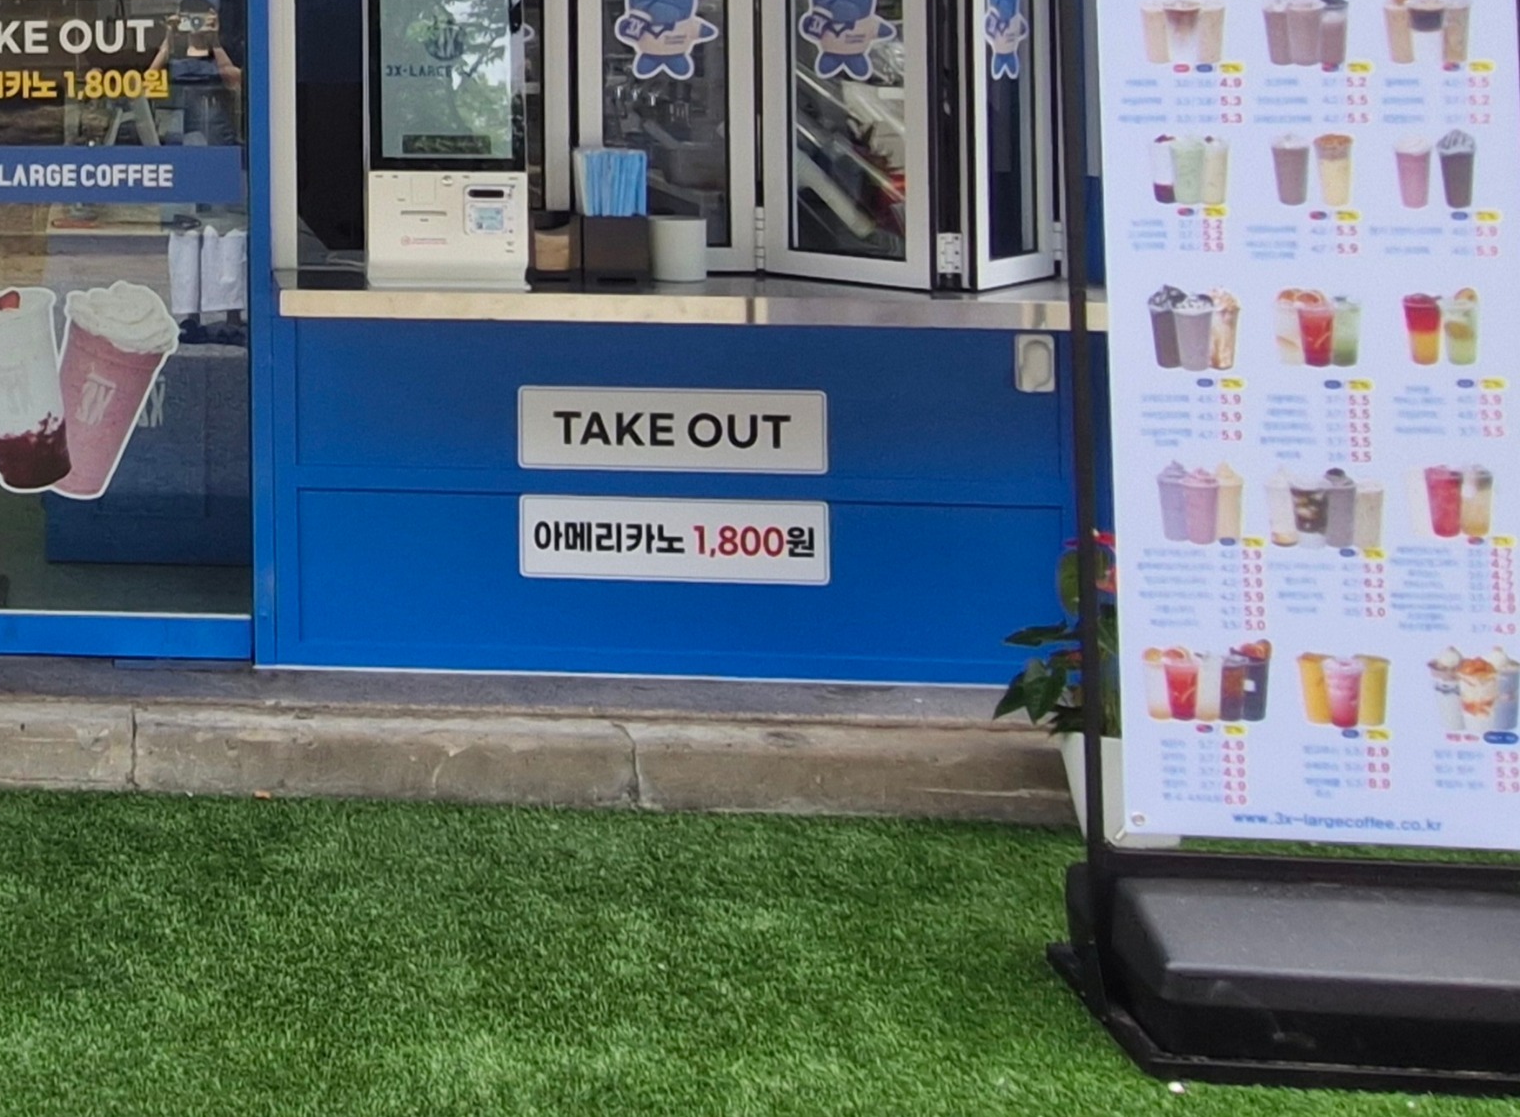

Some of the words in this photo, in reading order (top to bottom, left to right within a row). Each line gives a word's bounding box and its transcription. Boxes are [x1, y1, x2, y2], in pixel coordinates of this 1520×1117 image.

[59, 19, 155, 54] OUT
[64, 69, 169, 101] 1,800원
[80, 164, 174, 188] COFFEE
[553, 411, 675, 447] TAKE
[687, 412, 791, 449] OUT
[534, 521, 685, 554] 아메리카노
[693, 525, 815, 558] 1,800원
